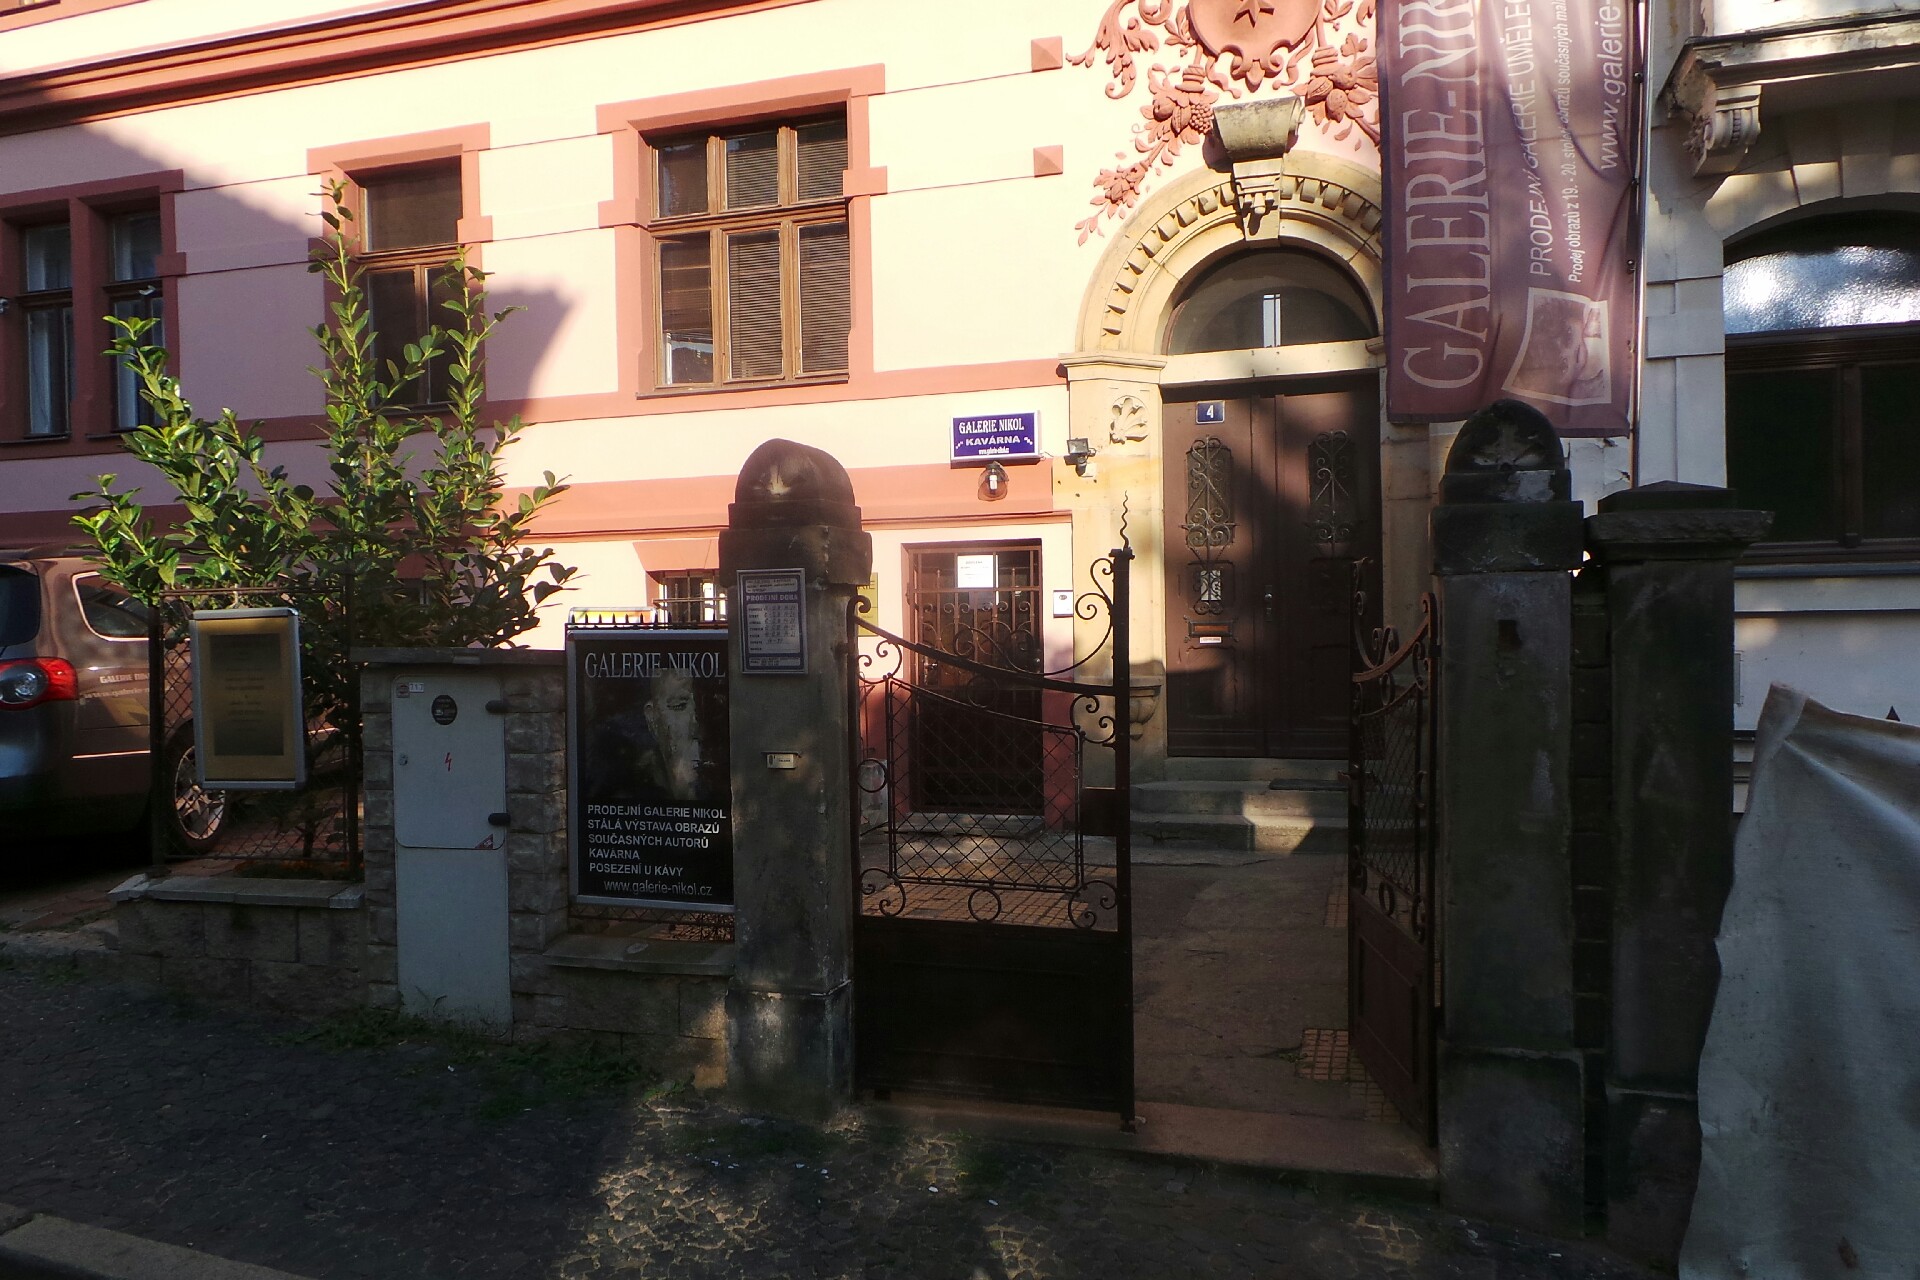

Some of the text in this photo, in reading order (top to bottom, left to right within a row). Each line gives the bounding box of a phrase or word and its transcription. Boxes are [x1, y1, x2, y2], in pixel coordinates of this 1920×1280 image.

[1550, 22, 1573, 85] současných
[1552, 86, 1571, 124] obrazů
[1499, 0, 1553, 277] PRODEJNÍ GALERIE UMĚLE
[1561, 161, 1578, 176] 20.
[1562, 184, 1579, 201] 19.
[1568, 202, 1580, 210] z
[1563, 211, 1582, 248] obrazů
[1568, 249, 1586, 283] Prodej
[1206, 404, 1214, 419] 4
[958, 417, 1025, 434] GALERIE NIKOL
[965, 435, 1021, 446] KAVÁRNA
[99, 673, 133, 684] GALERIE
[587, 804, 727, 819] PRODEJNÍ GALERIE NIKOL
[587, 818, 721, 834] STÁLÁ VÝSTAVA OBRAZŮ
[588, 832, 710, 848] SOUČASNÝCH AUTORŮ
[588, 847, 641, 860] KAVÁRNA
[589, 862, 684, 877] POSEZENÍ U KÁVY
[603, 879, 713, 896] www.galerie-nikol.cz
